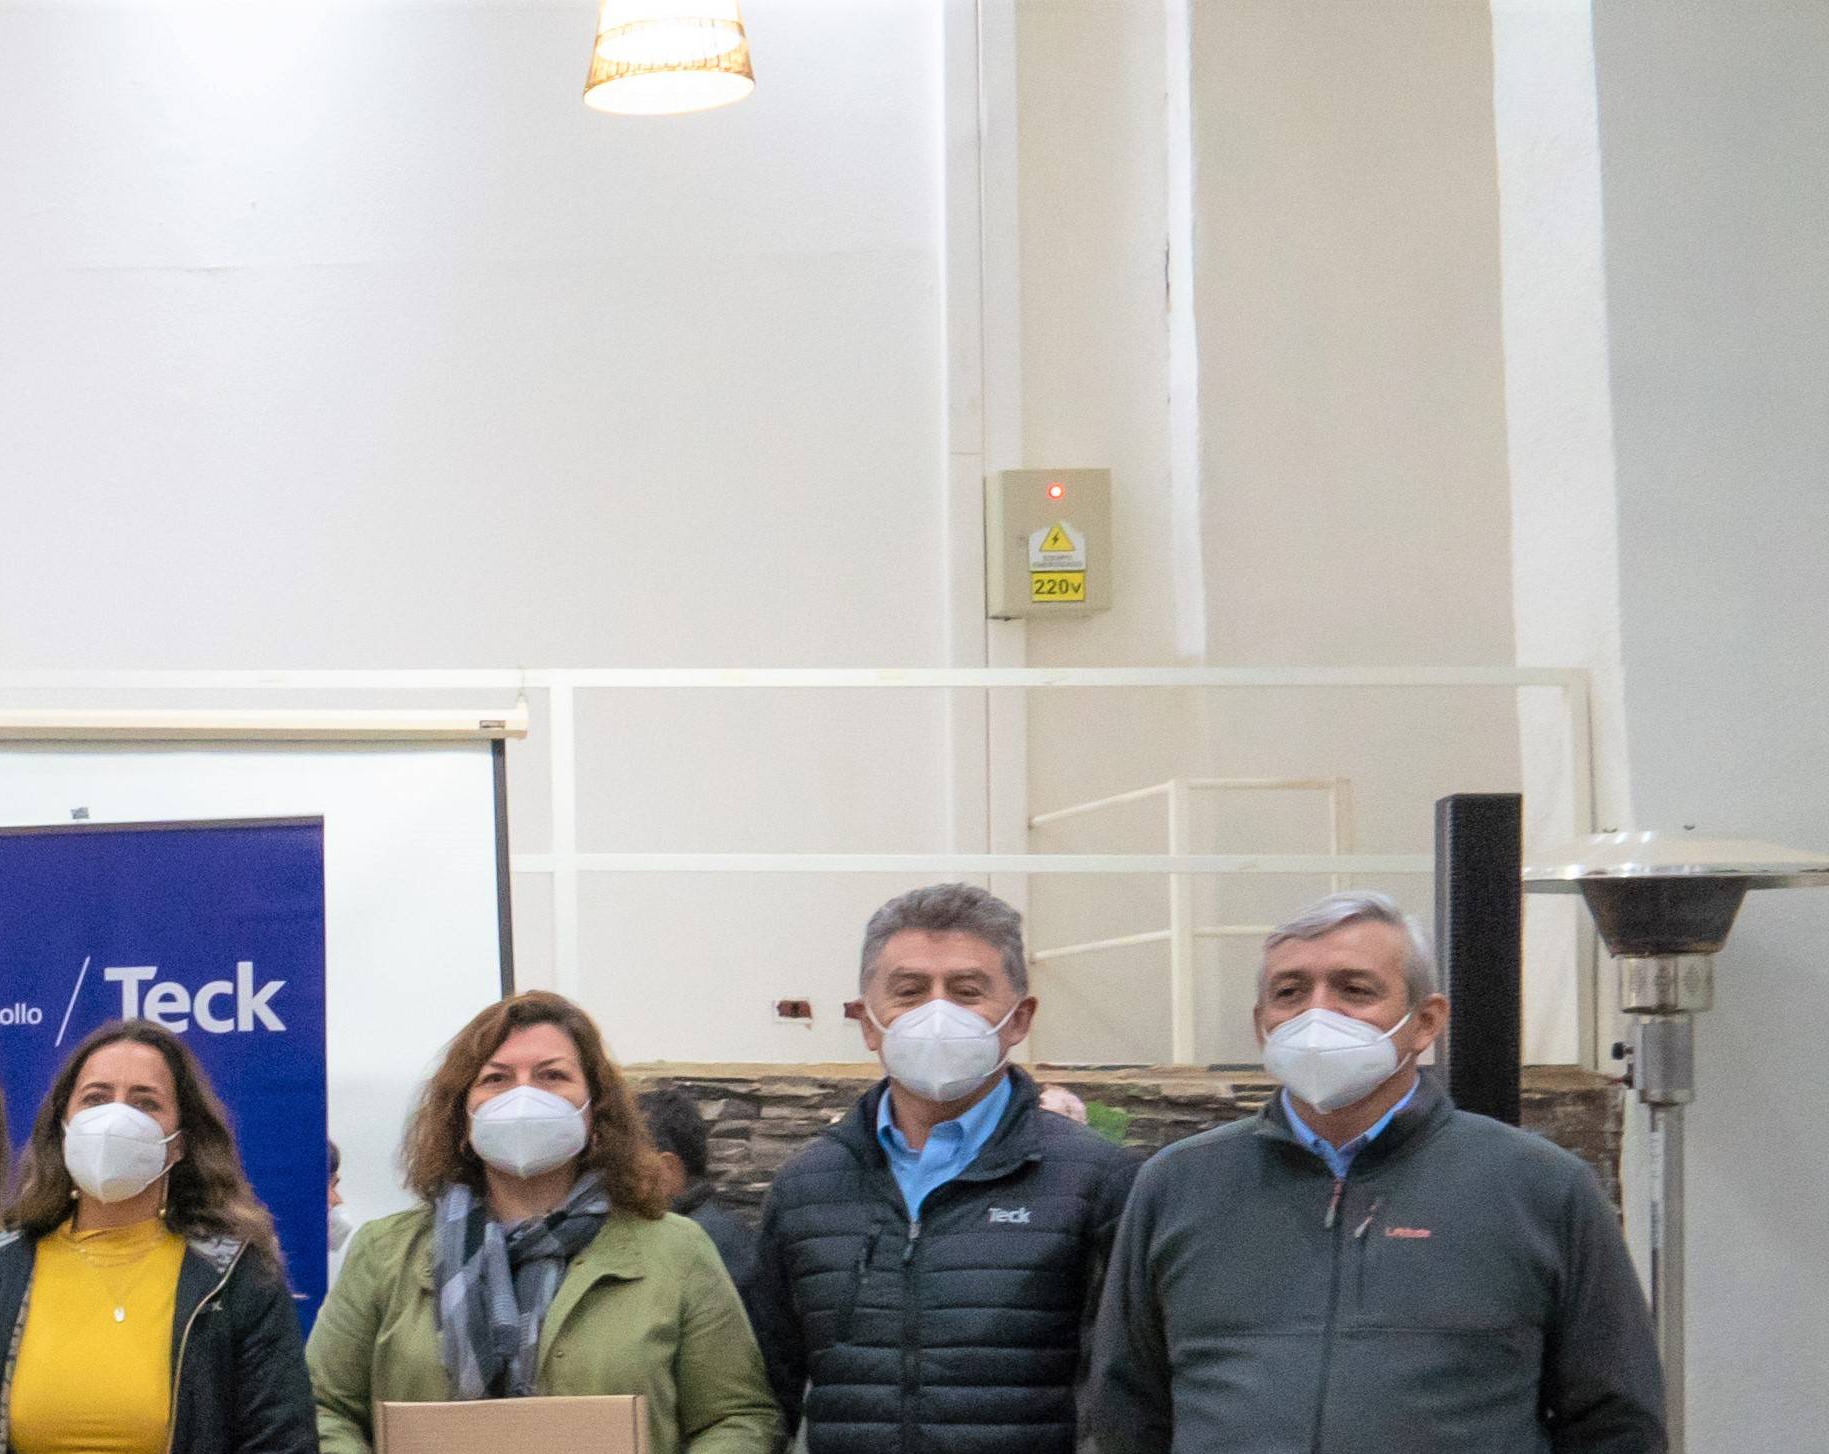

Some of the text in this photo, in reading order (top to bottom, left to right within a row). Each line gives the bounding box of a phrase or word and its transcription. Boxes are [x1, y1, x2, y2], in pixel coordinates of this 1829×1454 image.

[1034, 578, 1082, 595] 220v
[104, 961, 287, 1034] Teck
[988, 1207, 1032, 1224] Teck
